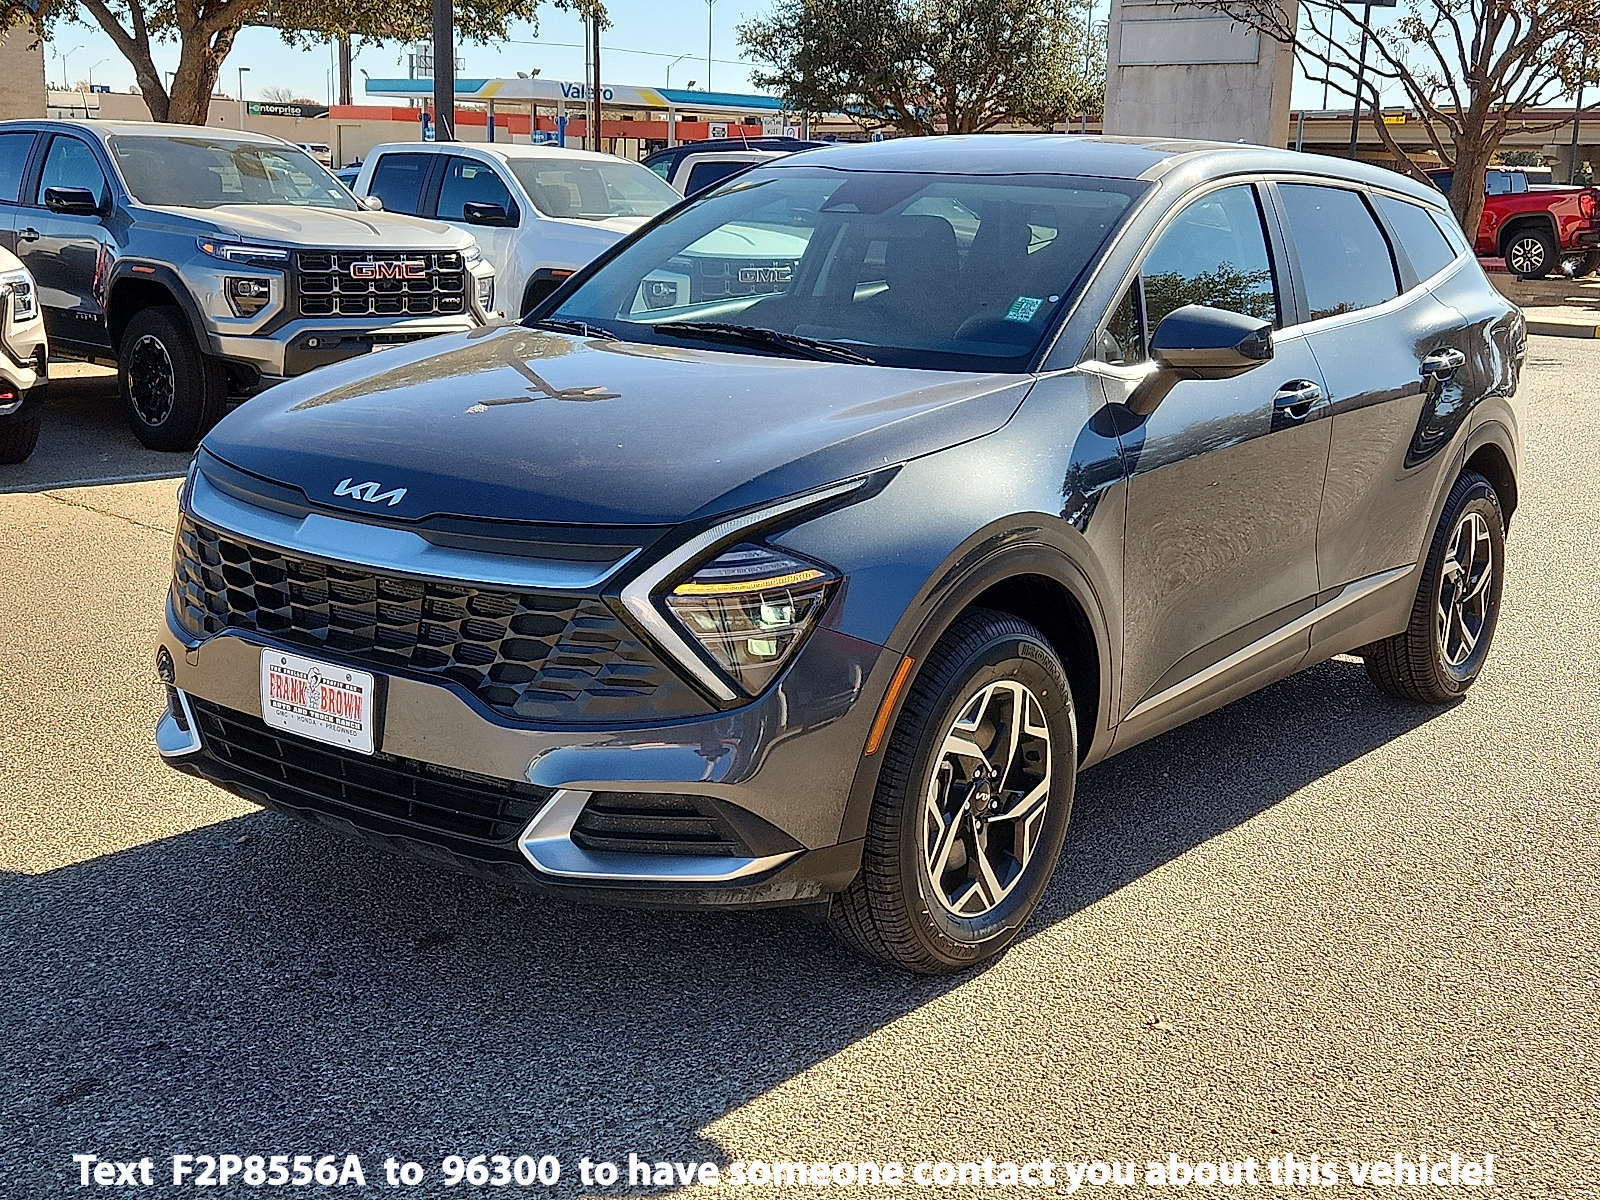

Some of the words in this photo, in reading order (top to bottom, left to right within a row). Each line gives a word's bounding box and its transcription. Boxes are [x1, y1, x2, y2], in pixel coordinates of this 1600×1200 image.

[249, 104, 302, 115] enterprise
[350, 262, 426, 279] GMC
[738, 266, 793, 283] GMC
[333, 477, 408, 507] KIA
[270, 664, 282, 672] THE
[269, 672, 307, 706] FRANK
[320, 685, 363, 722] BROWN
[272, 700, 291, 711] AUTO
[292, 707, 308, 716] AND
[309, 711, 334, 723] TRUCK
[335, 717, 362, 731] RANCH
[296, 715, 317, 726] HONDA
[325, 722, 358, 737] PREOWNED
